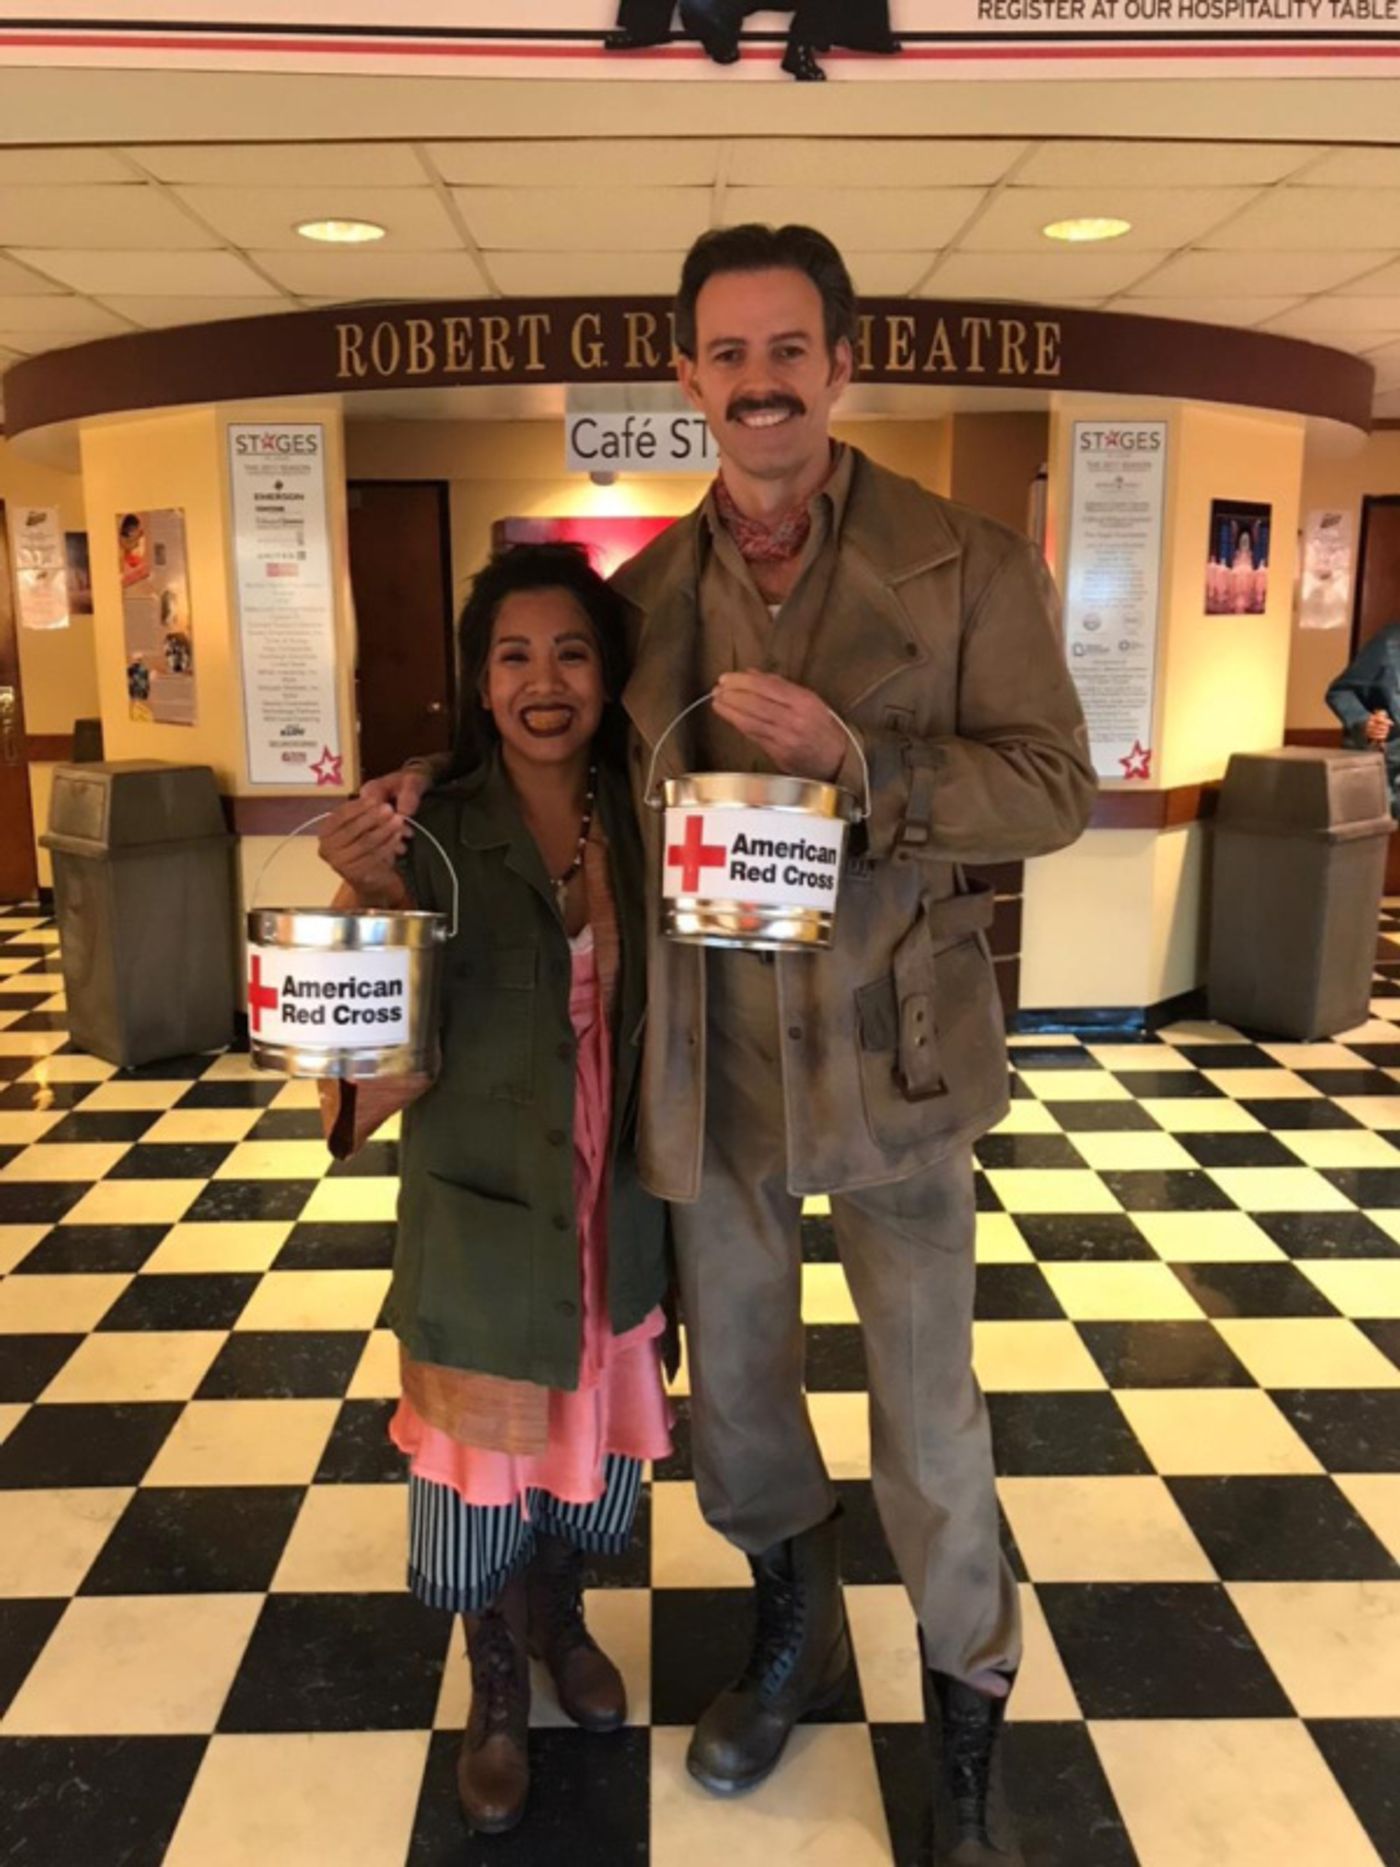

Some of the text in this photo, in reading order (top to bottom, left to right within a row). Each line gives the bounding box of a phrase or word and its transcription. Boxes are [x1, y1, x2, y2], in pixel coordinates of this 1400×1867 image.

[977, 0, 1399, 20] REGISTER AT OUR HOSPITALITY TABLE
[336, 314, 550, 378] ROBERT
[858, 314, 1061, 377] HEATRE
[571, 416, 718, 459] Café ST
[731, 833, 837, 865] American
[730, 862, 834, 890] Red Cross
[281, 976, 403, 998] American
[281, 1004, 403, 1025] Red Cross
